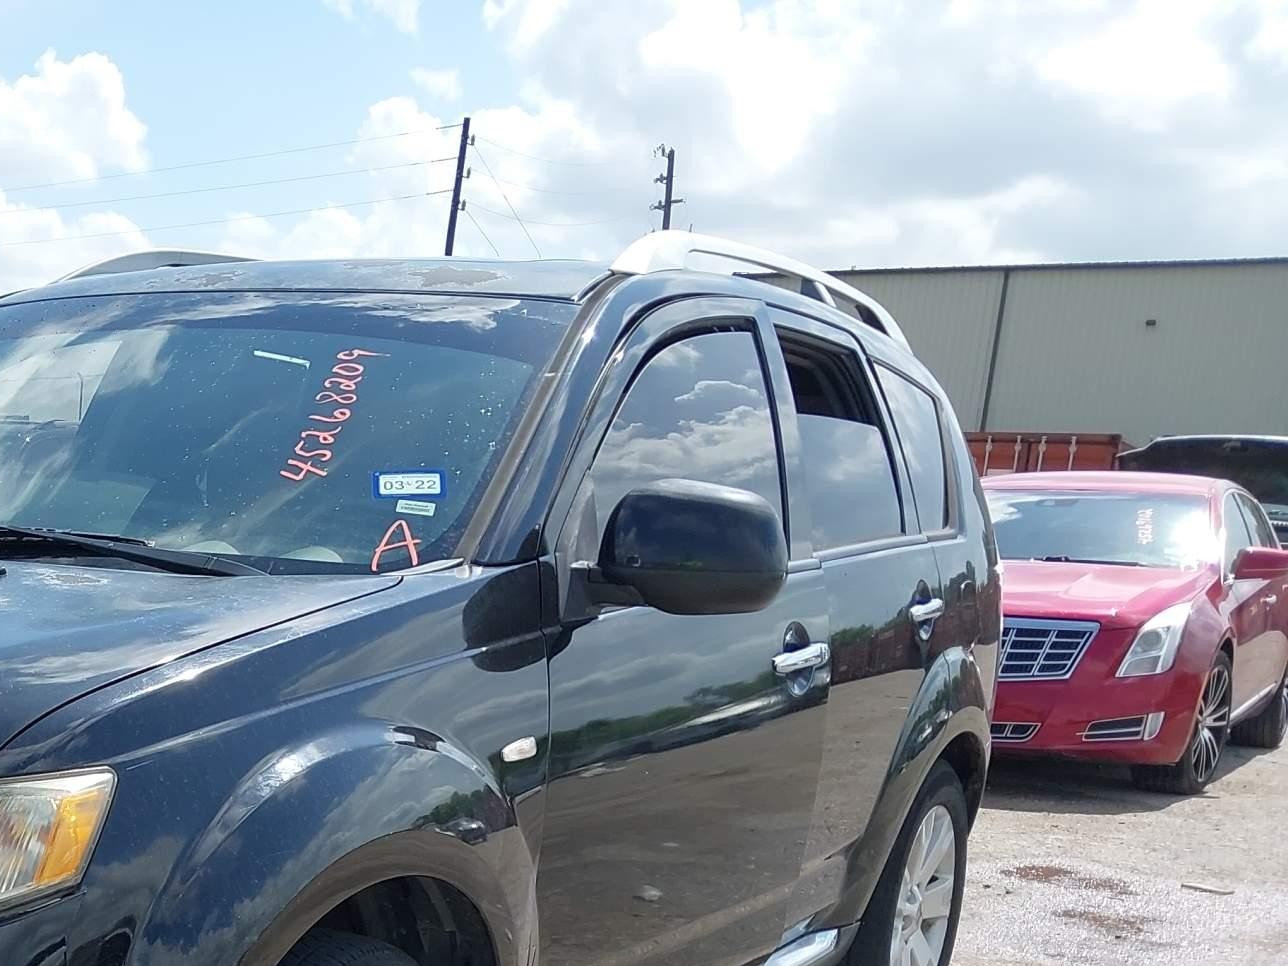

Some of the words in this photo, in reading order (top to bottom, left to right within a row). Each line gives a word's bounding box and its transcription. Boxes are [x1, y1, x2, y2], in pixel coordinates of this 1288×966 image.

[280, 349, 391, 481] 45268209
[383, 480, 405, 491] 03
[415, 479, 437, 490] 22
[370, 519, 422, 572] A
